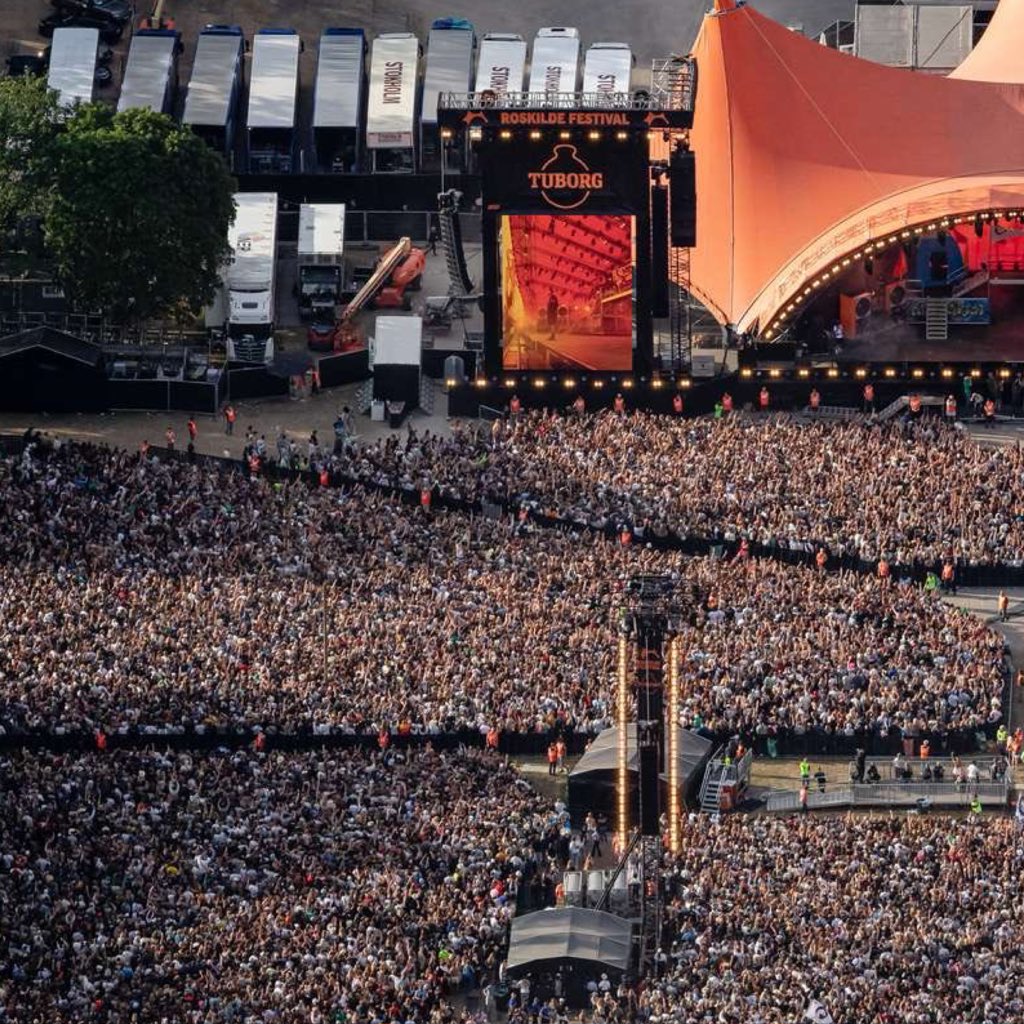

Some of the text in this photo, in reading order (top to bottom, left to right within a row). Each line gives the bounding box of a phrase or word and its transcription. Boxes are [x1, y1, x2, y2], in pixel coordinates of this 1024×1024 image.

[501, 112, 630, 125] ROSKILDE FESTIVAL
[528, 172, 603, 189] TUBORG
